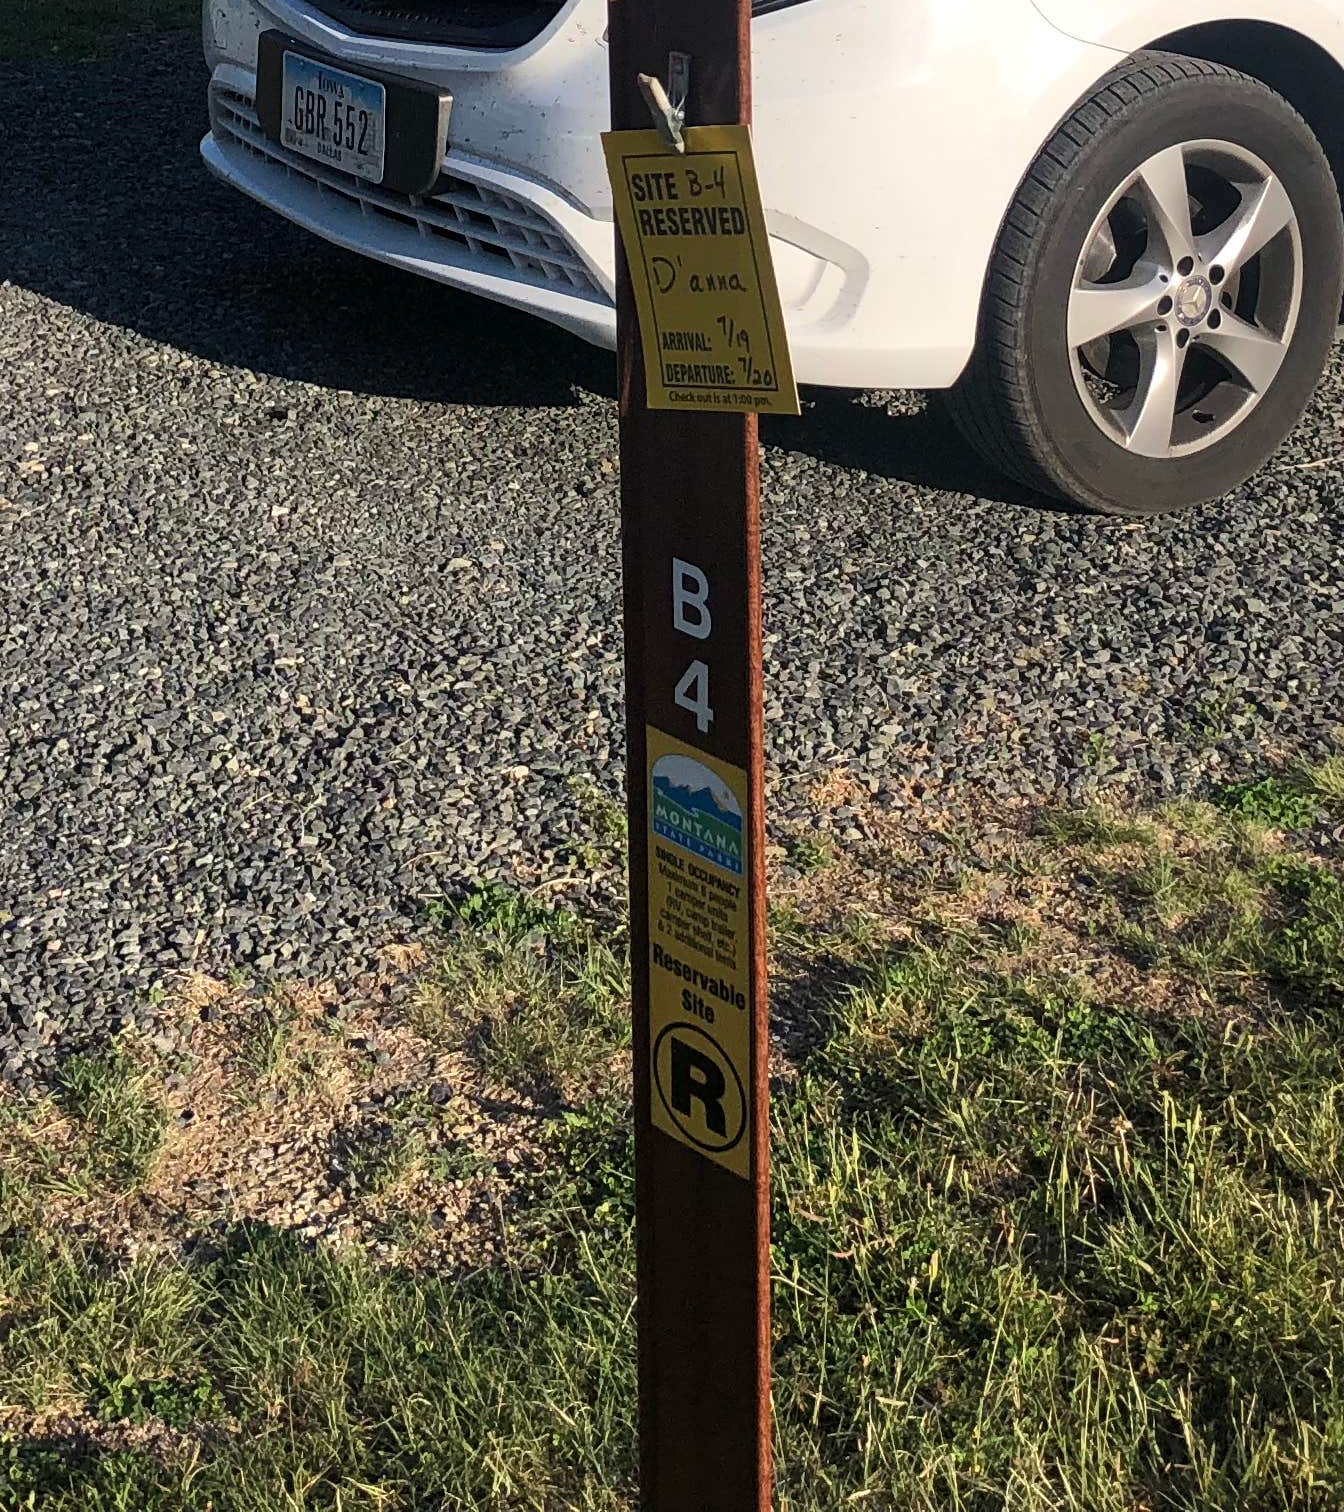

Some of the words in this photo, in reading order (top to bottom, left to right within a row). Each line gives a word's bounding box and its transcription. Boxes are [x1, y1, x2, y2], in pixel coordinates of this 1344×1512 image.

[294, 86, 327, 141] GBR
[333, 102, 369, 155] 552
[631, 173, 679, 202] SITE
[686, 166, 726, 198] B-4
[637, 207, 745, 236] RESERVED
[662, 332, 712, 352] ARRIVAL:
[717, 315, 750, 353] 7/19
[666, 363, 736, 384] DEPARTURE:
[738, 357, 773, 385] 7/20
[669, 391, 694, 402] Check
[673, 557, 712, 639] B
[675, 659, 714, 733] 4
[656, 804, 739, 855] MONTANA
[653, 943, 746, 1011] Reservable
[681, 988, 716, 1025] Site
[671, 1035, 728, 1139] R
